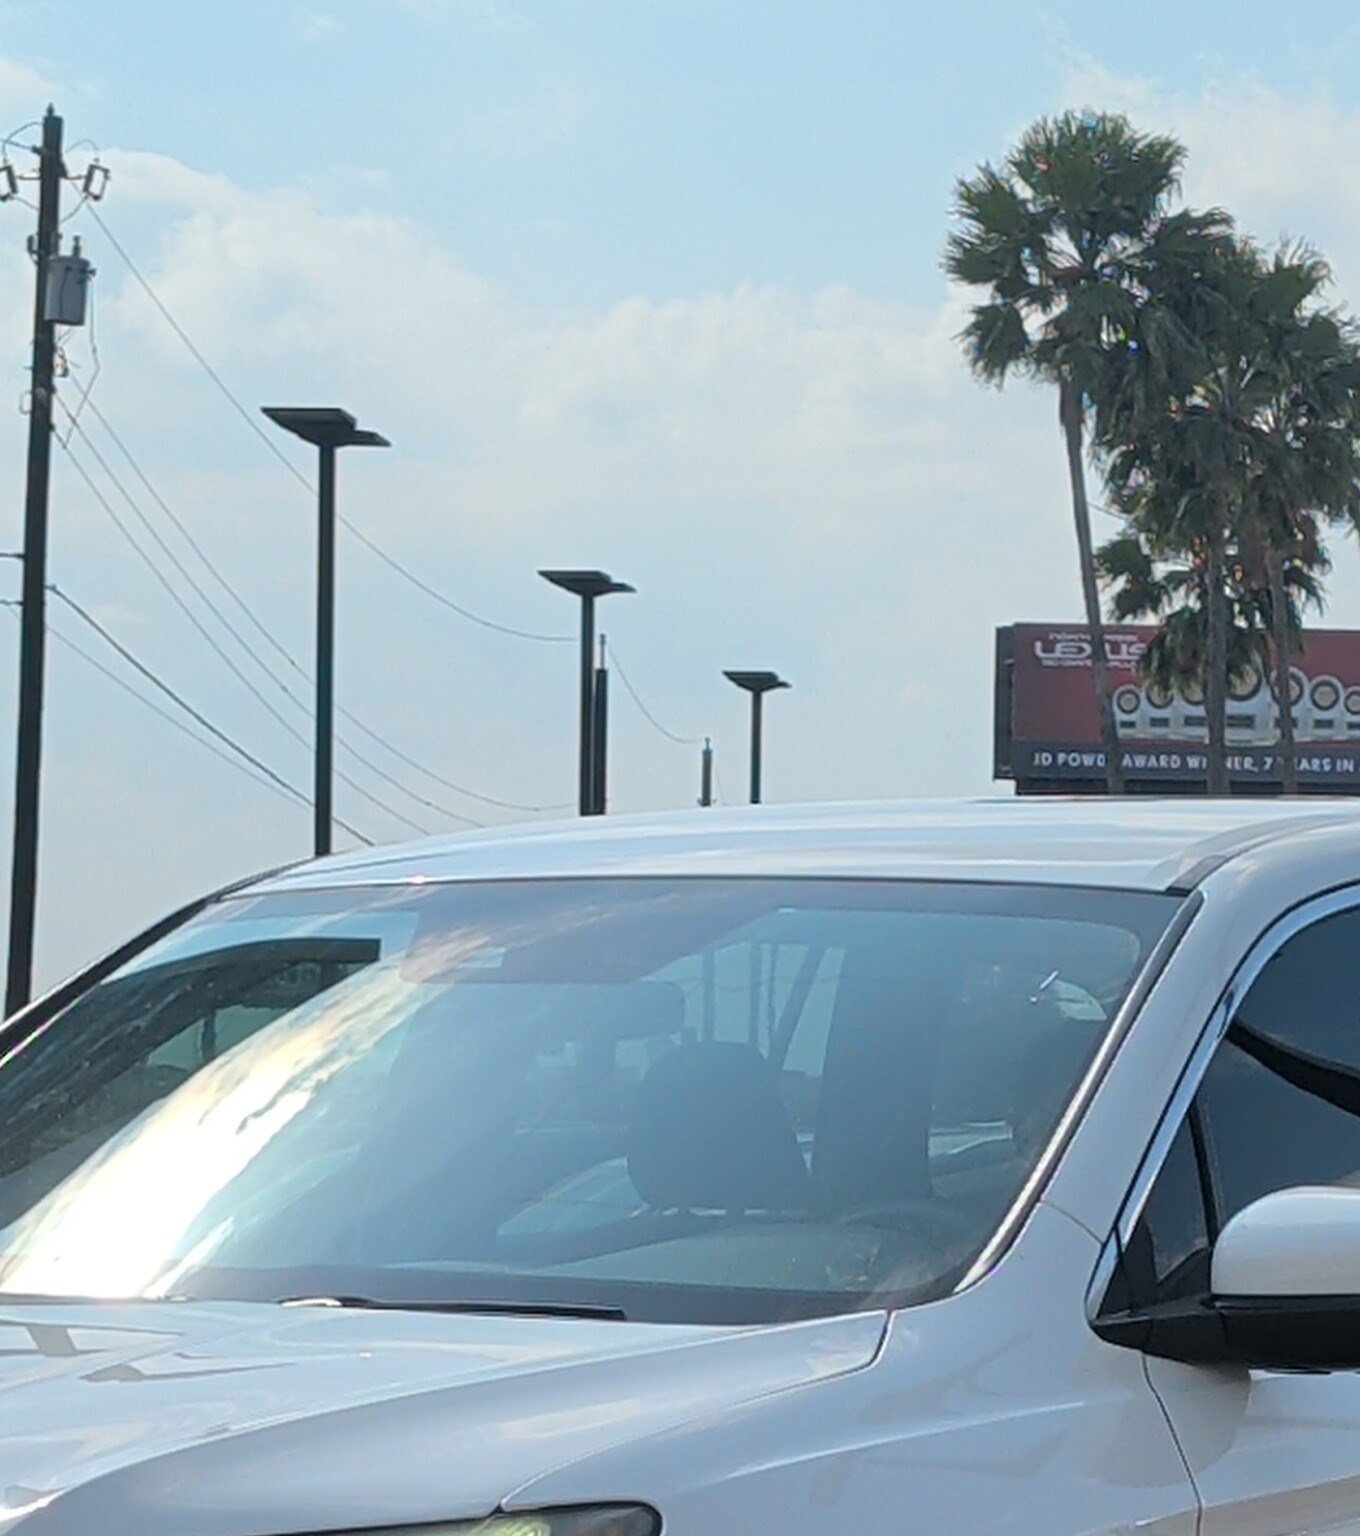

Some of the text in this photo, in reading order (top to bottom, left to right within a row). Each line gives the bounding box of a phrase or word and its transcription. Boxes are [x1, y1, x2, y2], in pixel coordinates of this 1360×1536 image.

[1034, 640, 1147, 661] LEUS
[1121, 754, 1181, 769] AWARD
[1336, 759, 1355, 773] IN
